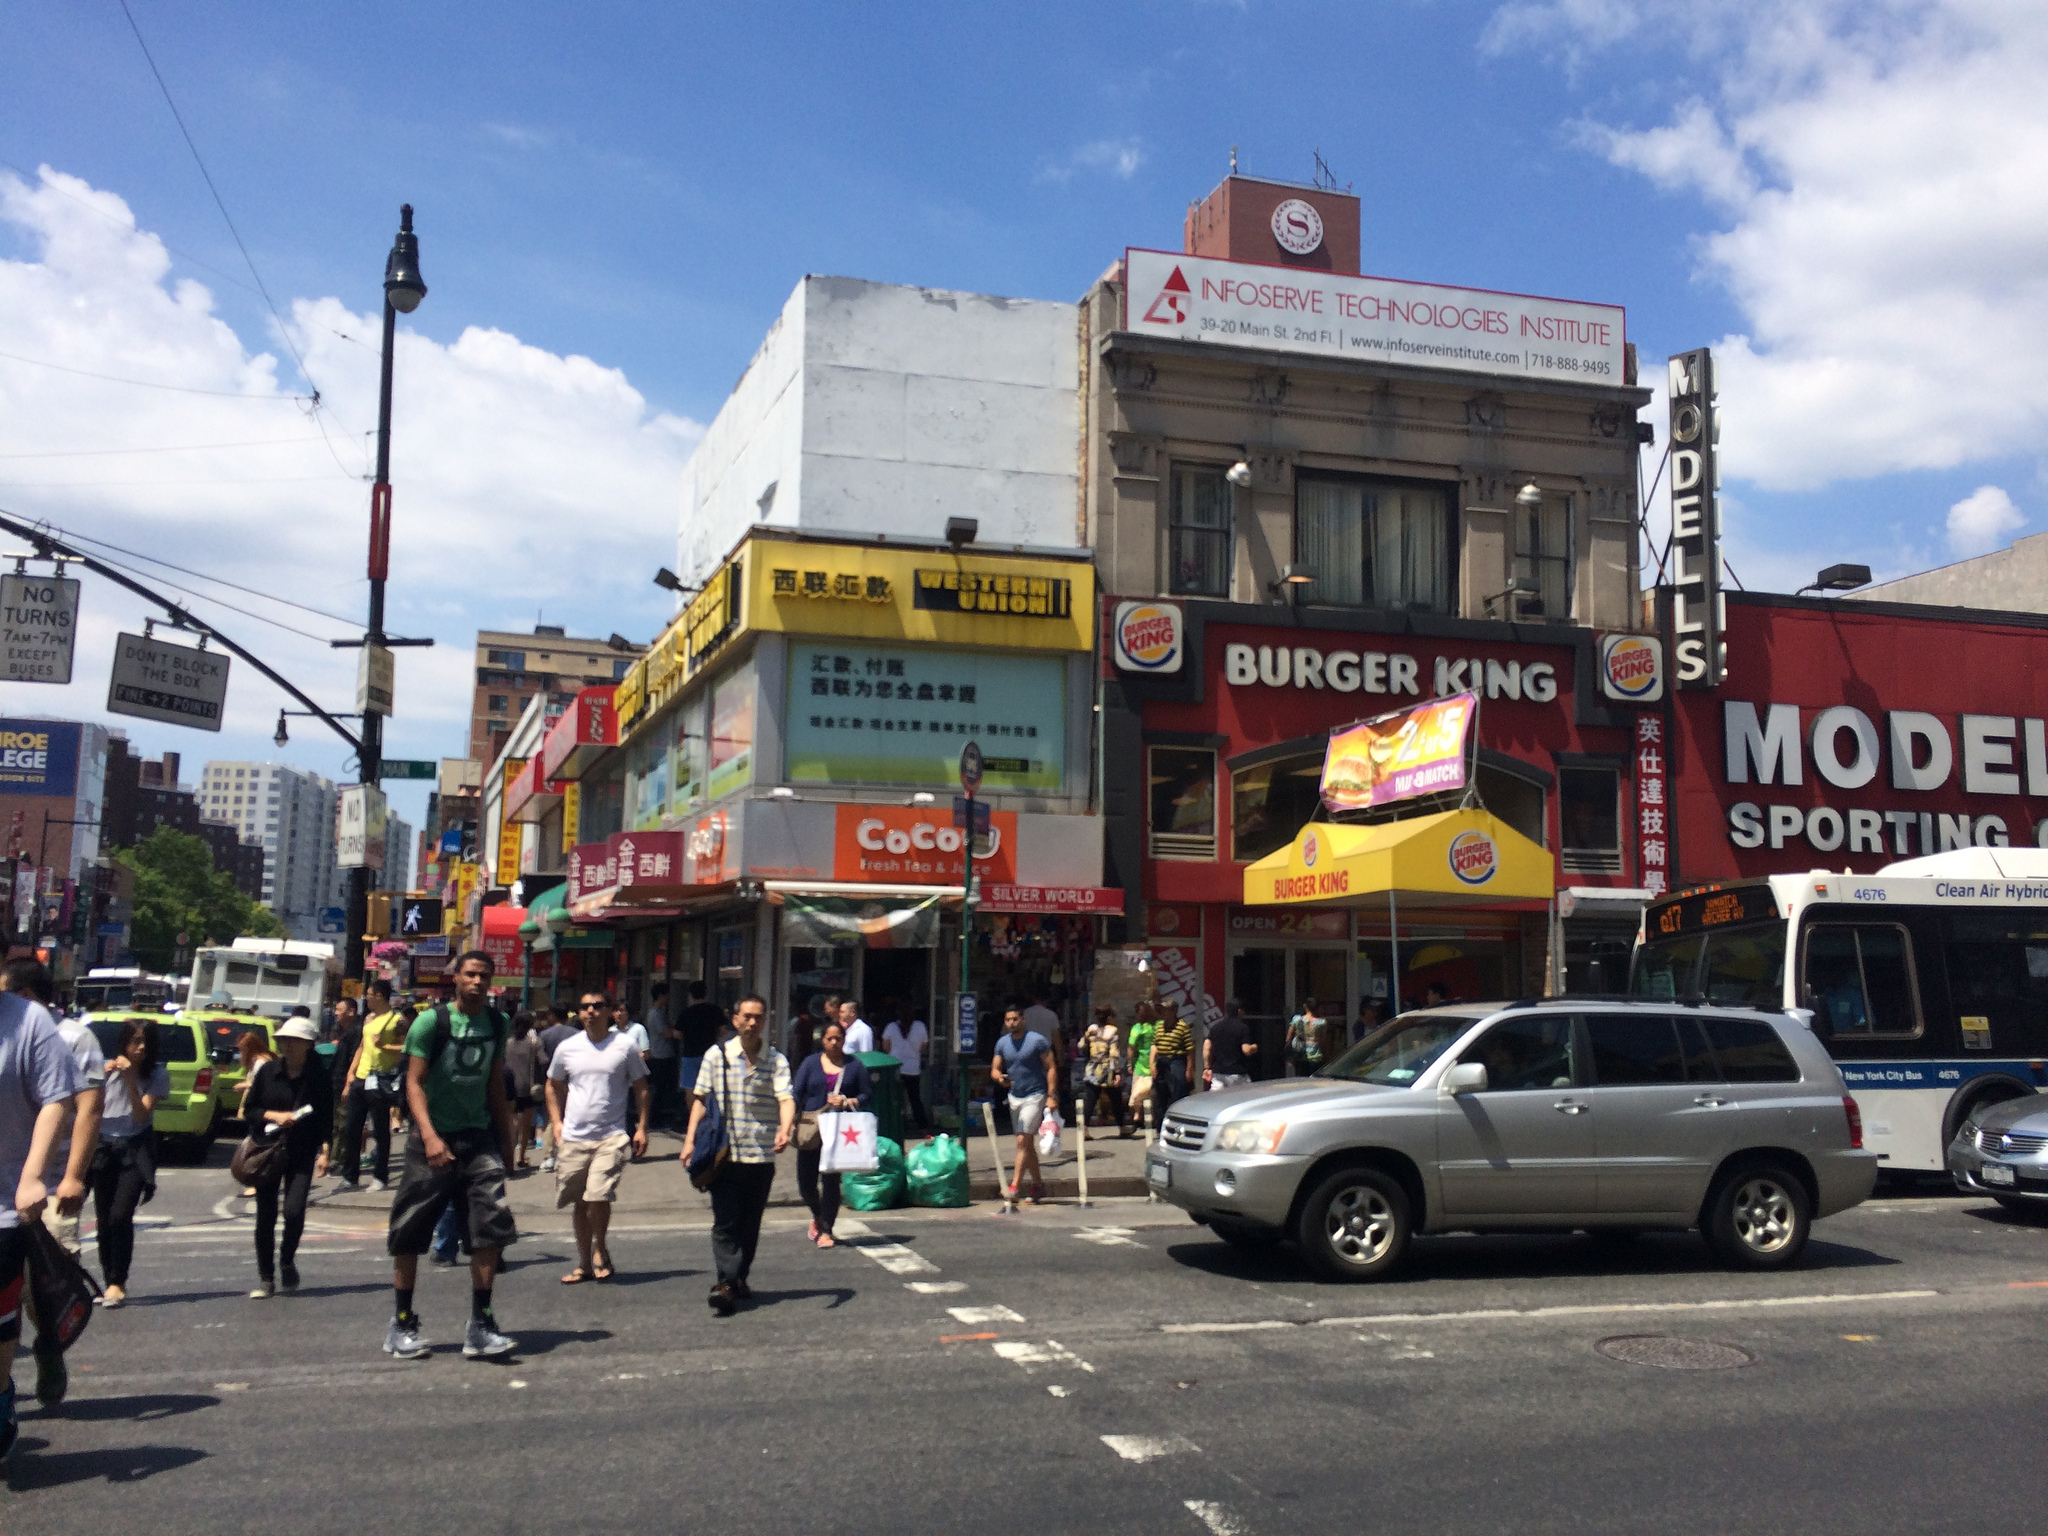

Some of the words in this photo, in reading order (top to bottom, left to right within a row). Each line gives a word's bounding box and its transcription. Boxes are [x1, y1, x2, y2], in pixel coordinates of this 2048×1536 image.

[1202, 278, 1323, 313] INFOSERVE
[1336, 292, 1509, 334] TECHNOLOGIES
[1520, 314, 1611, 346] INSTITUTE
[1201, 318, 1236, 333] 39-20
[1240, 322, 1270, 337] Main
[1294, 328, 1317, 342] 2nd
[1351, 336, 1520, 365] www.infoserveinstitute.com
[1531, 354, 1611, 375] 718-888-9495
[918, 570, 1047, 596] WESTERN
[23, 586, 55, 603] NO
[958, 592, 1047, 614] UNION
[5, 607, 71, 627] TURNS
[1124, 616, 1171, 639] BURGER
[3, 628, 68, 645] 7AM-7PM
[1127, 629, 1174, 655] KING
[8, 648, 57, 660] EXCEPT
[1610, 648, 1653, 669] BURGER
[9, 663, 54, 675] BUSES
[141, 665, 168, 682] THE
[174, 673, 200, 688] BOX
[173, 656, 219, 677] BLOCK
[1226, 642, 1420, 696] BURGER
[1434, 656, 1557, 702] KING
[1612, 660, 1655, 683] KING
[0, 731, 49, 750] ROE
[1396, 720, 1420, 762] 2
[0, 750, 47, 769] EGE
[1730, 802, 2010, 855] SPORTING
[1454, 841, 1491, 859] BURGER
[860, 857, 900, 871] Fresh
[904, 859, 932, 872] Tea
[935, 861, 946, 873] &
[951, 861, 992, 875] Juce
[1455, 850, 1493, 872] KING
[1274, 874, 1316, 899] BURGER
[1319, 870, 1348, 893] KING
[1854, 888, 1887, 901] 4676
[1936, 883, 1976, 898] Clean
[1980, 883, 2000, 898] Air
[992, 887, 1040, 902] SILVER
[1044, 889, 1096, 904] WORLD
[1232, 916, 1276, 930] OPEN
[1280, 912, 1313, 934] 24
[1845, 1070, 1864, 1081] New
[1866, 1070, 1886, 1081] York
[1887, 1070, 1905, 1083] City
[1906, 1071, 1923, 1081] Bus
[1939, 1070, 1960, 1080] 4676
